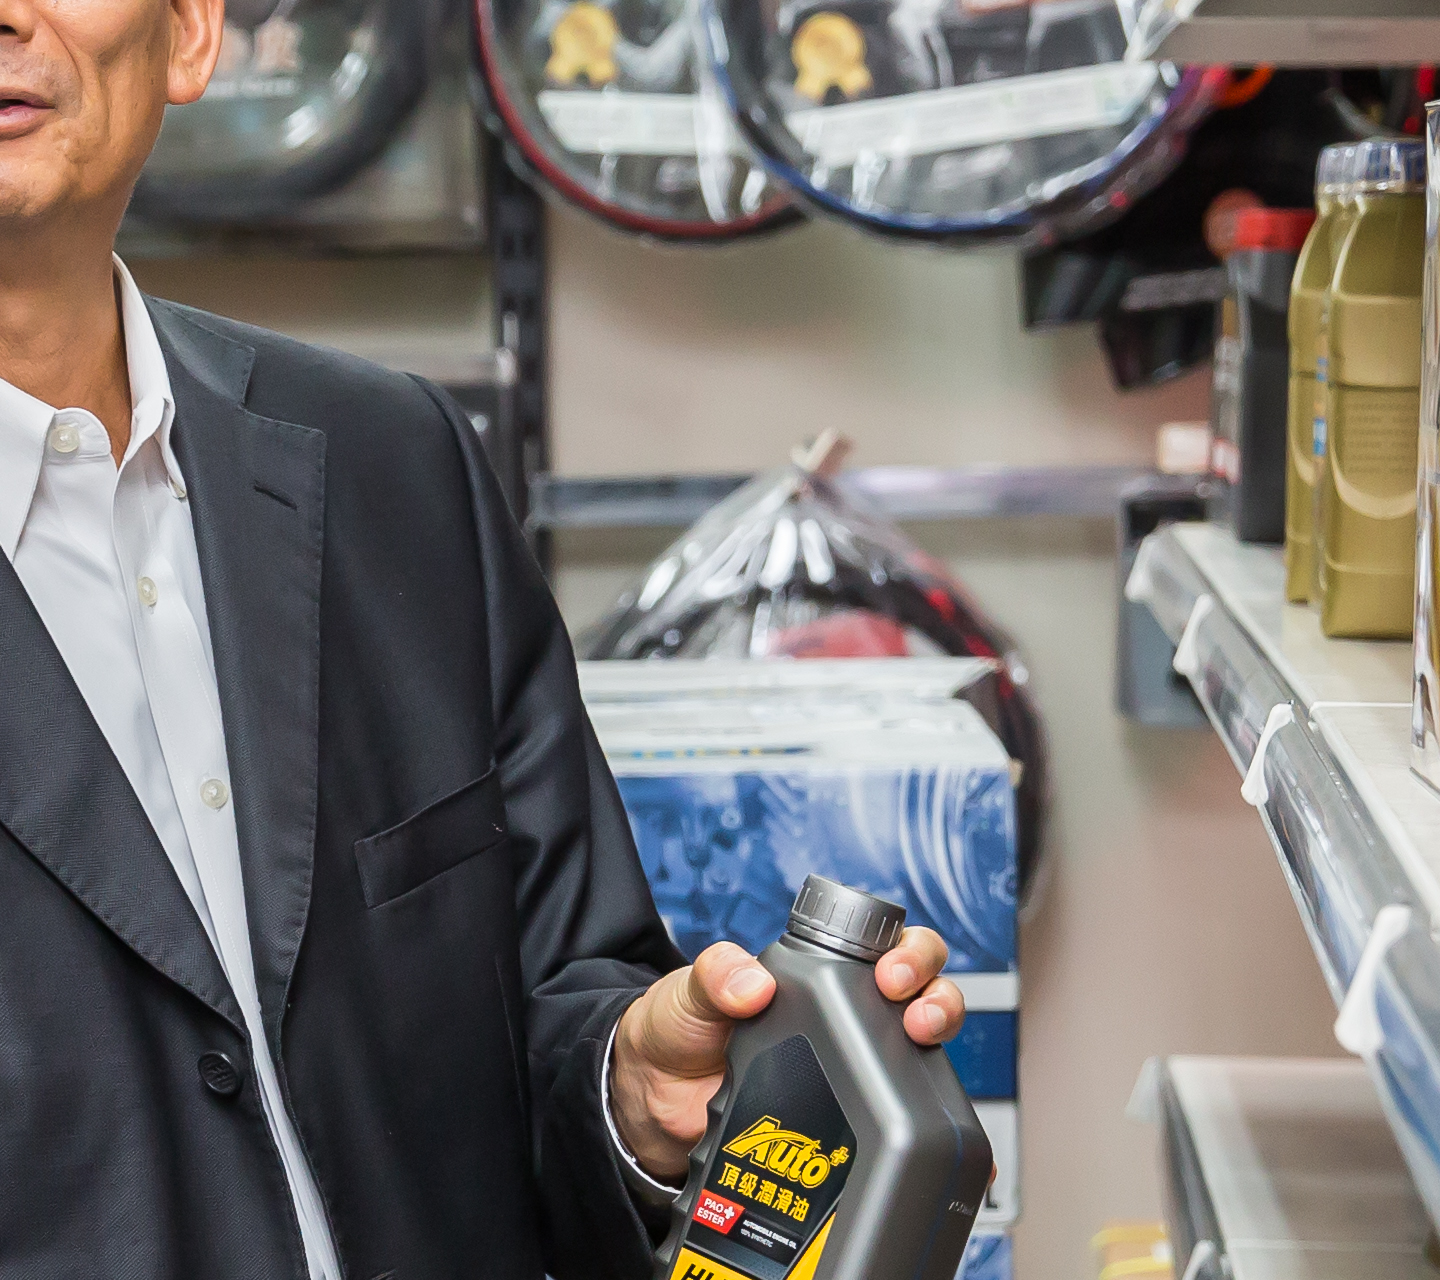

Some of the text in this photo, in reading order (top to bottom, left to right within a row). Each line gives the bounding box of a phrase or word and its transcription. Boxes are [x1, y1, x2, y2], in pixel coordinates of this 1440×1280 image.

[718, 1162, 810, 1222] 頂級潤滑油
[704, 1197, 724, 1213] PAO
[697, 1207, 725, 1227] ESTER
